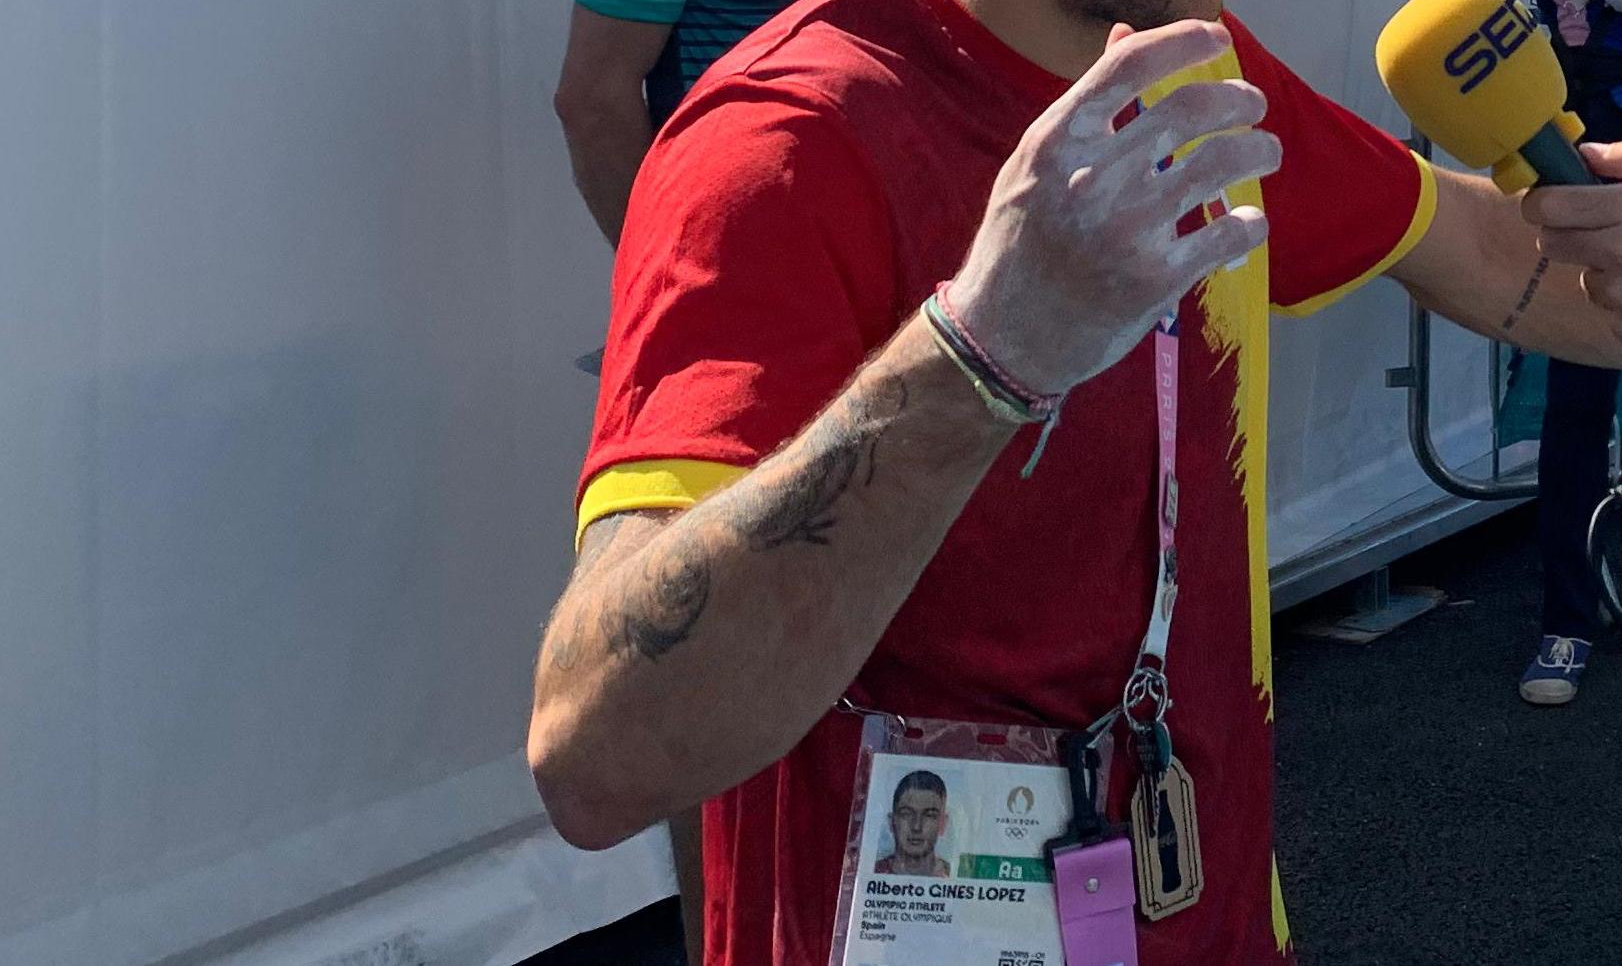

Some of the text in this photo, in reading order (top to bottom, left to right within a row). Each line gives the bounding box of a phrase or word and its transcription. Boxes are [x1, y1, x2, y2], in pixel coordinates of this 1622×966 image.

[999, 861, 1023, 879] Aa
[866, 880, 1025, 902] Alberto GINES LOPEZ
